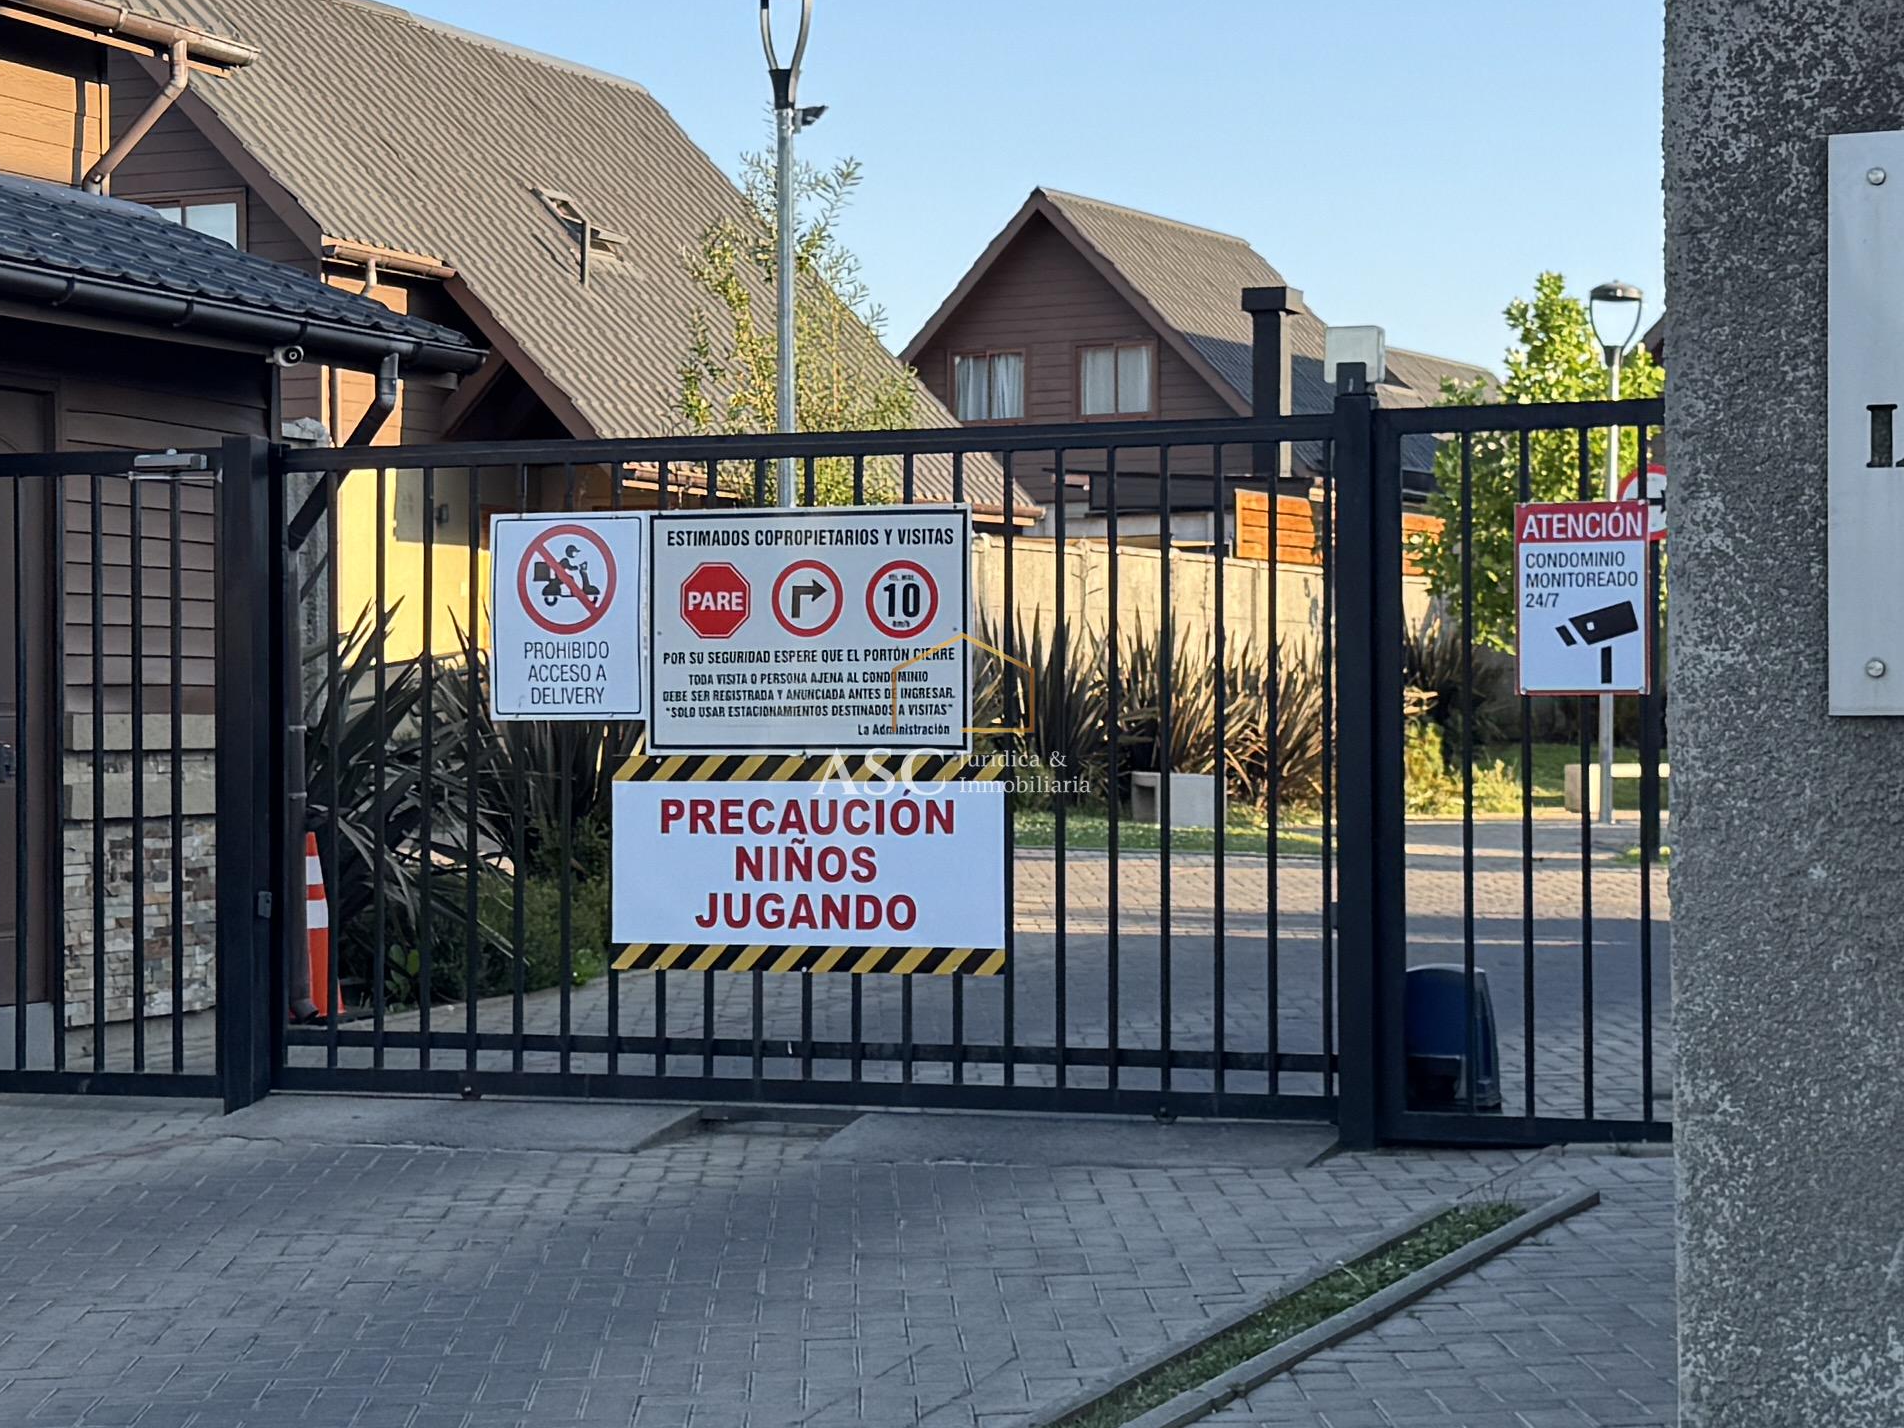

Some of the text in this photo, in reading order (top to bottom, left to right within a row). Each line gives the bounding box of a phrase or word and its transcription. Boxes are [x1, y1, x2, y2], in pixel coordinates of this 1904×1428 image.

[1522, 506, 1643, 540] ATENCIÓN
[667, 527, 954, 547] ESTIMADOS COPROPIETARIOS Y VISITAS
[1525, 551, 1625, 569] CONDOMINIO
[1525, 571, 1638, 589] MONITOREADO
[687, 591, 745, 611] PARE
[883, 582, 921, 618] 10
[1525, 592, 1559, 608] 24/7
[523, 640, 610, 660] PROHIBIDO
[663, 646, 956, 664] POR SU SEGURIDAD ESPERE QUE EL PORTÓN CIERRE
[527, 664, 607, 682] ACCESO A
[688, 673, 714, 686] TODA
[716, 673, 748, 685] VISITA
[760, 672, 808, 685] PERSONA
[810, 672, 844, 684] AJENA
[847, 671, 860, 683] AL
[531, 687, 605, 705] DELIVERY
[663, 690, 688, 702] DEBE
[691, 690, 710, 702] SER
[712, 689, 775, 701] REGISTRADA
[777, 689, 784, 700] Y
[786, 688, 846, 700] ANUNCIADA
[848, 688, 881, 699] ANTES
[698, 706, 726, 718] USAR
[728, 704, 829, 717] ESTACIONAMIENTOS
[898, 703, 905, 716] A
[858, 723, 870, 736] La
[660, 789, 955, 836] PRECAUCIÓN
[735, 837, 878, 883] NIÑOS
[694, 892, 918, 932] JUGANDO
